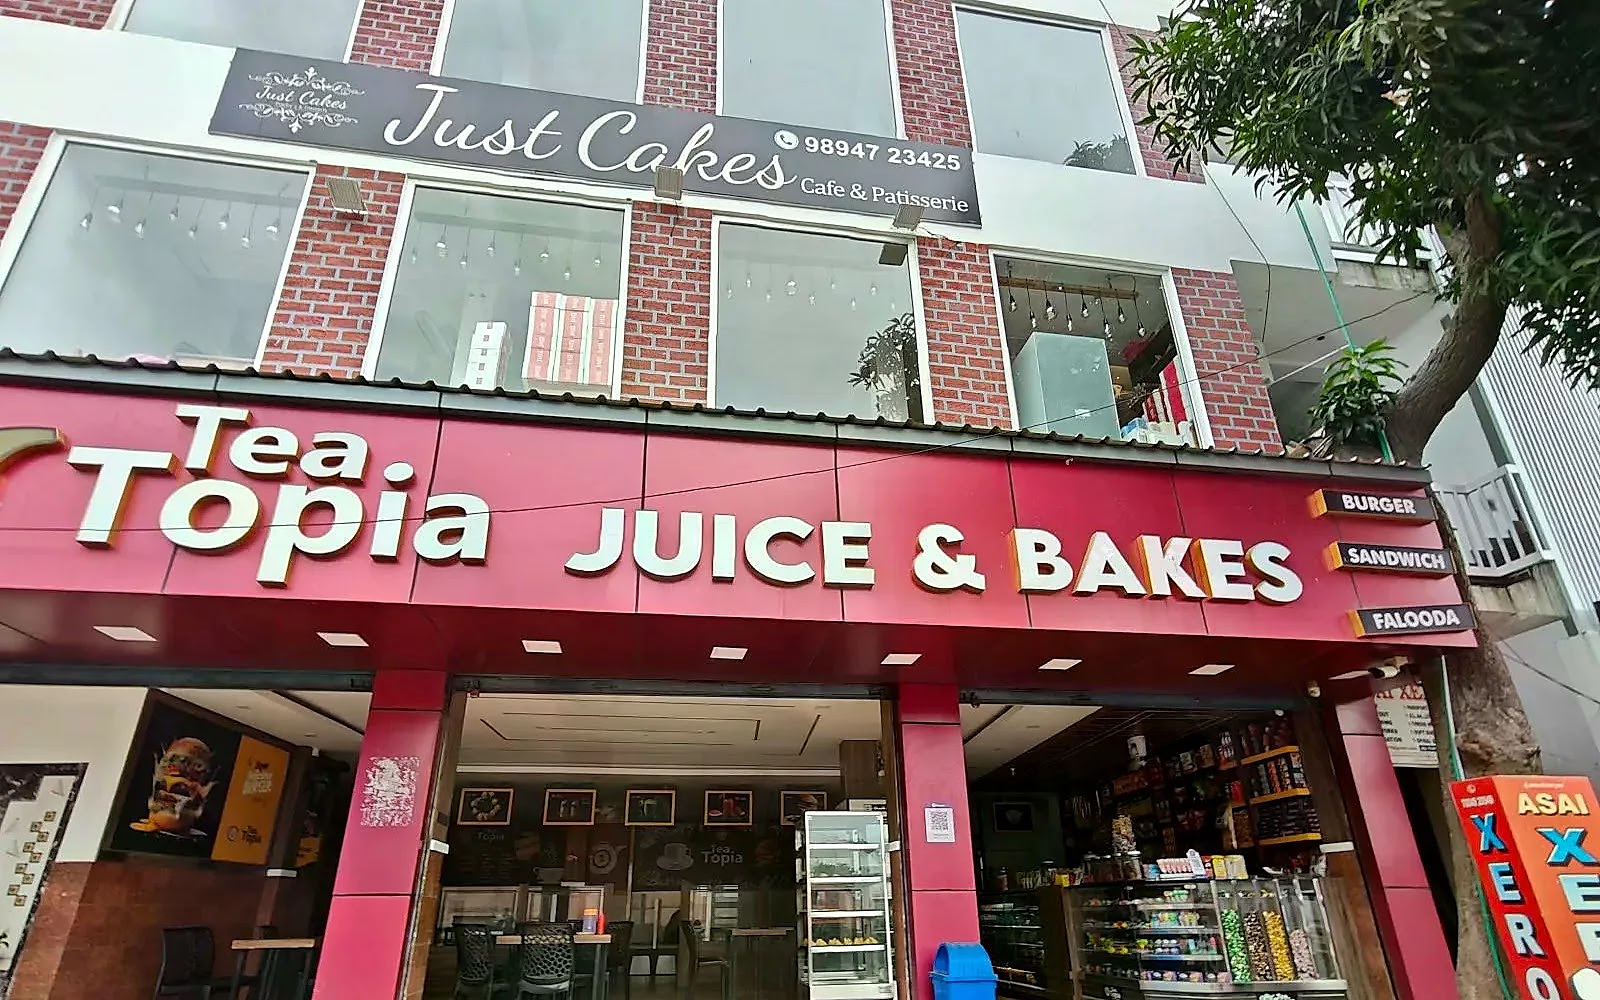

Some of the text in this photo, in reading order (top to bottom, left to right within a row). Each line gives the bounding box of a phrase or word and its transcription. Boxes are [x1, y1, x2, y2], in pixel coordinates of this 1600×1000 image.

[255, 85, 295, 102] Just
[299, 91, 346, 110] Cakes
[383, 83, 798, 190] Just Cakes
[804, 136, 961, 171] 98947 23425
[800, 177, 969, 212] Cafe & Patisserie
[175, 403, 370, 482] Tea
[67, 446, 492, 587] Topia
[1341, 494, 1416, 514] BURGER
[564, 507, 1303, 603] JUICE & BAKES
[1348, 547, 1446, 570] SANDWICH
[1372, 609, 1461, 629] FALOODA
[1518, 792, 1590, 815] ASAI
[701, 850, 744, 867] Topia
